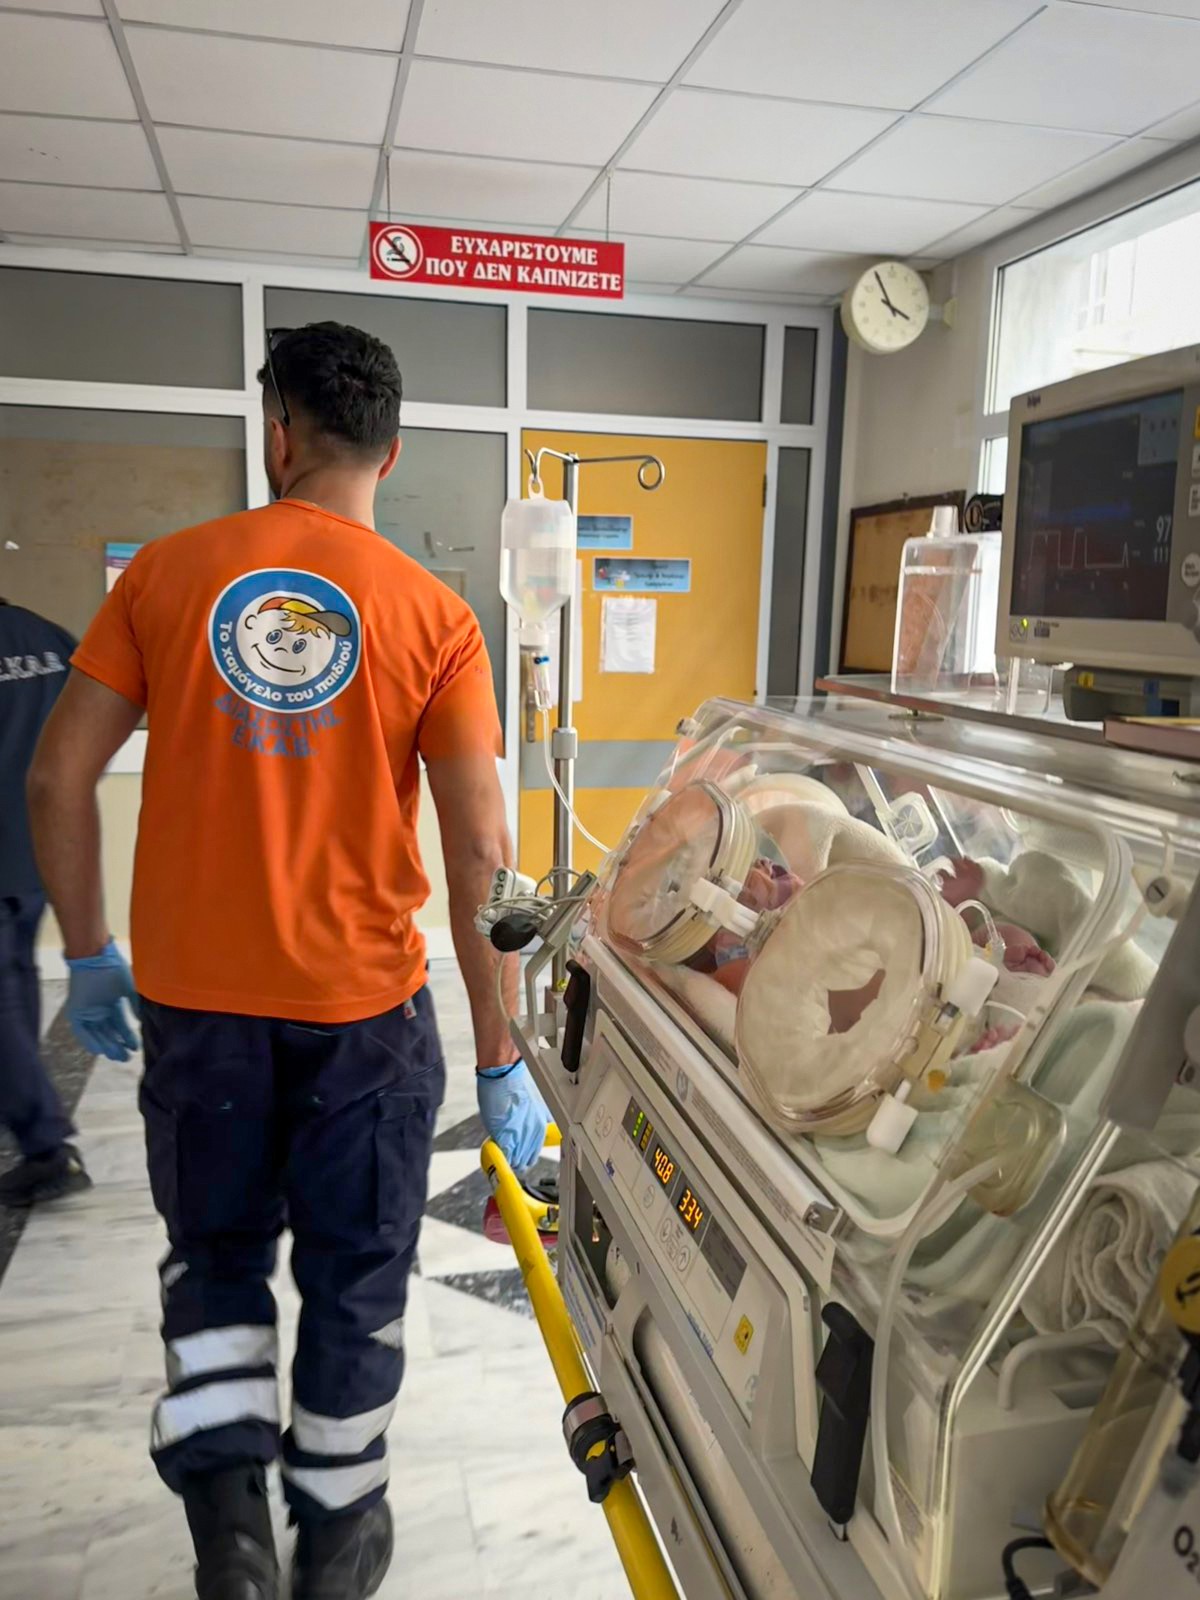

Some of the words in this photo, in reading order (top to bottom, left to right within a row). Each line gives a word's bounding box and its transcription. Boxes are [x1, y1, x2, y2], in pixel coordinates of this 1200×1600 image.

[451, 236, 598, 265] ΕΥΧΑΡΙΣΤΟΥΜΕ
[425, 257, 468, 277] ΠΟΥ
[474, 264, 511, 282] ΔΕΝ
[517, 267, 621, 291] ΚΑΠΝΙΖΕΤΕ
[219, 621, 233, 642] Το
[221, 646, 282, 702] χαμόγελο
[314, 640, 353, 694] παιδιού
[286, 688, 315, 703] του
